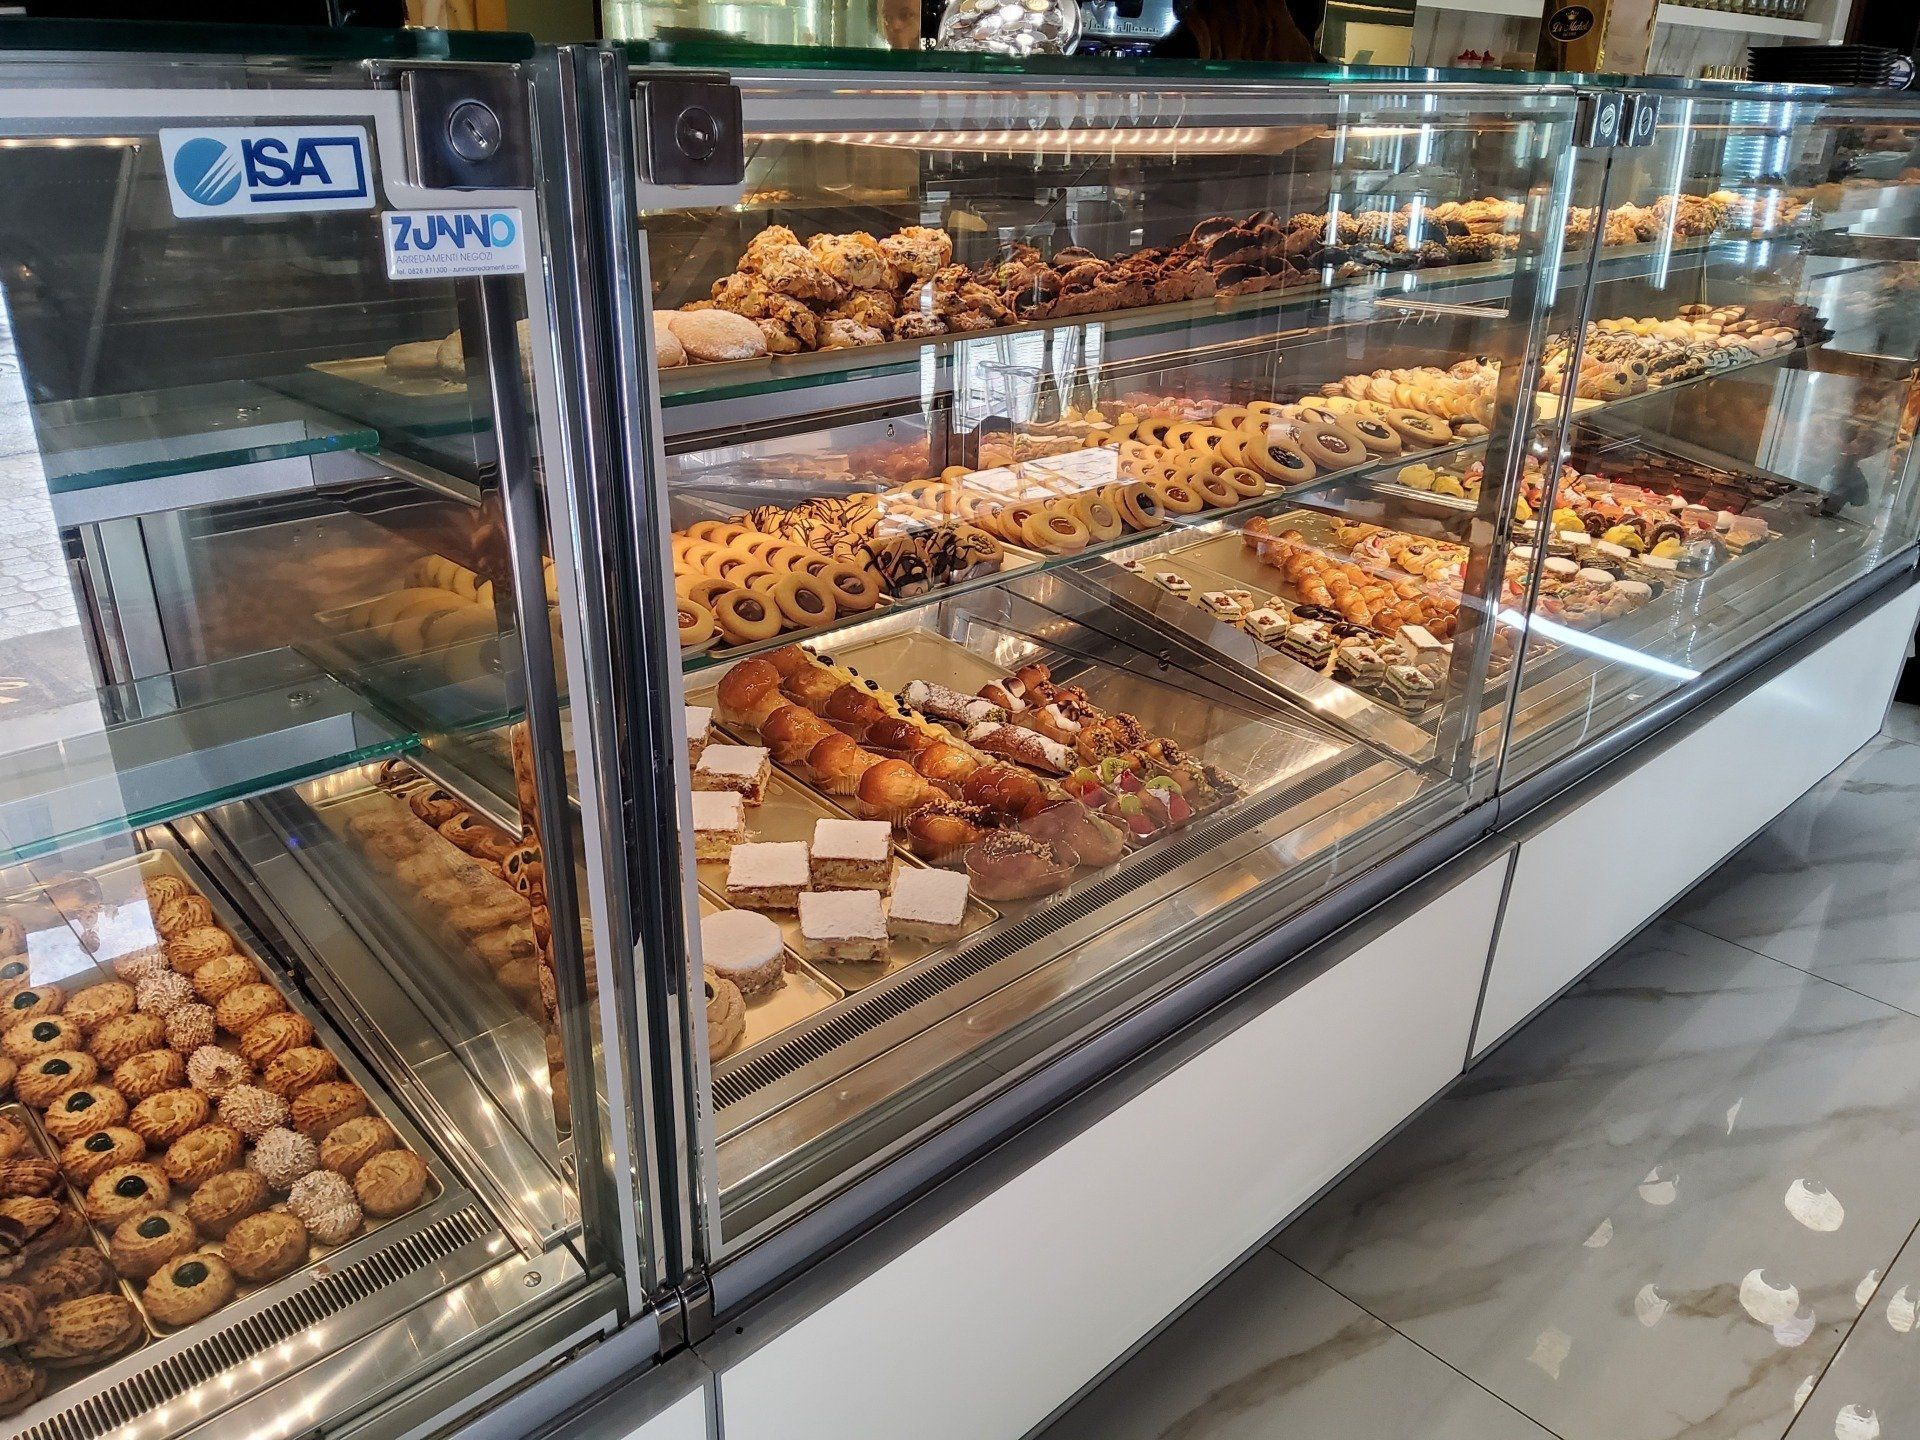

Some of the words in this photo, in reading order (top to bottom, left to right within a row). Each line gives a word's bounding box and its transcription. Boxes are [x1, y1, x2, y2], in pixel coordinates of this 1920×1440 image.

[241, 138, 332, 187] ISA
[391, 213, 516, 251] ZUNNO
[396, 253, 458, 264] ARREDAMENTI
[460, 251, 493, 261] NEGOZI
